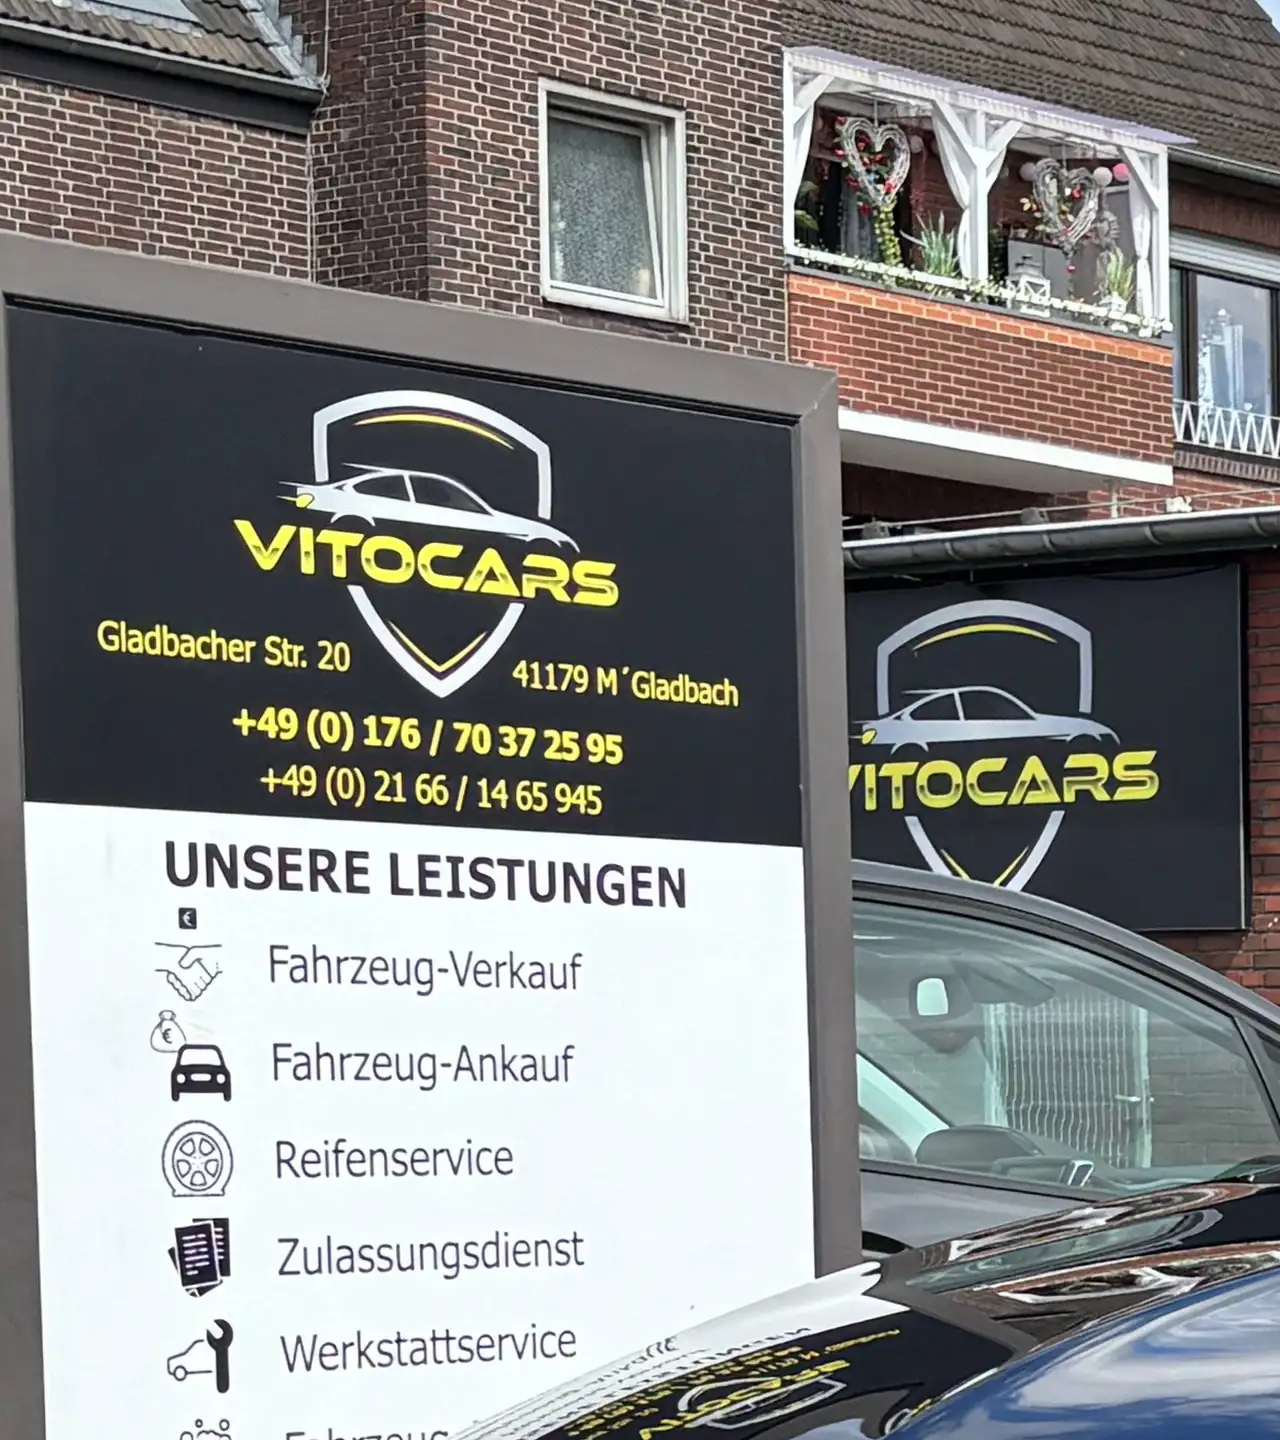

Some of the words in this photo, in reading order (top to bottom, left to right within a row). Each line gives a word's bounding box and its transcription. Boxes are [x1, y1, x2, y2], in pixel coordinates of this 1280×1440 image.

[234, 519, 620, 607] VITOCARS
[97, 620, 256, 662] Gladbacher
[265, 636, 307, 668] Str.
[319, 640, 351, 672] 20
[512, 662, 590, 693] 41179
[232, 706, 299, 741] +49
[306, 710, 355, 753] (0)
[363, 715, 422, 750] 176
[430, 719, 444, 757] /
[452, 722, 492, 755] 70
[498, 725, 537, 757] 37
[543, 728, 581, 762] 25
[585, 733, 624, 765] 95
[260, 765, 317, 796] +49
[325, 767, 366, 808] (0)
[375, 769, 405, 803] 21
[415, 773, 449, 806] 66
[455, 776, 467, 809] /
[480, 780, 508, 809] 14
[515, 782, 549, 812] 65
[554, 783, 603, 815] 945
[165, 840, 371, 895] UNSERE
[389, 852, 686, 909] LEISTUNGEN
[269, 943, 583, 997] Fahrzeug-Verkauf
[272, 1041, 575, 1092] Fahrzeug-Ankauf
[275, 1138, 514, 1179] Reifenservice
[277, 1230, 585, 1280] Zulassungsdienst
[279, 1323, 577, 1373] Werkstattservice
